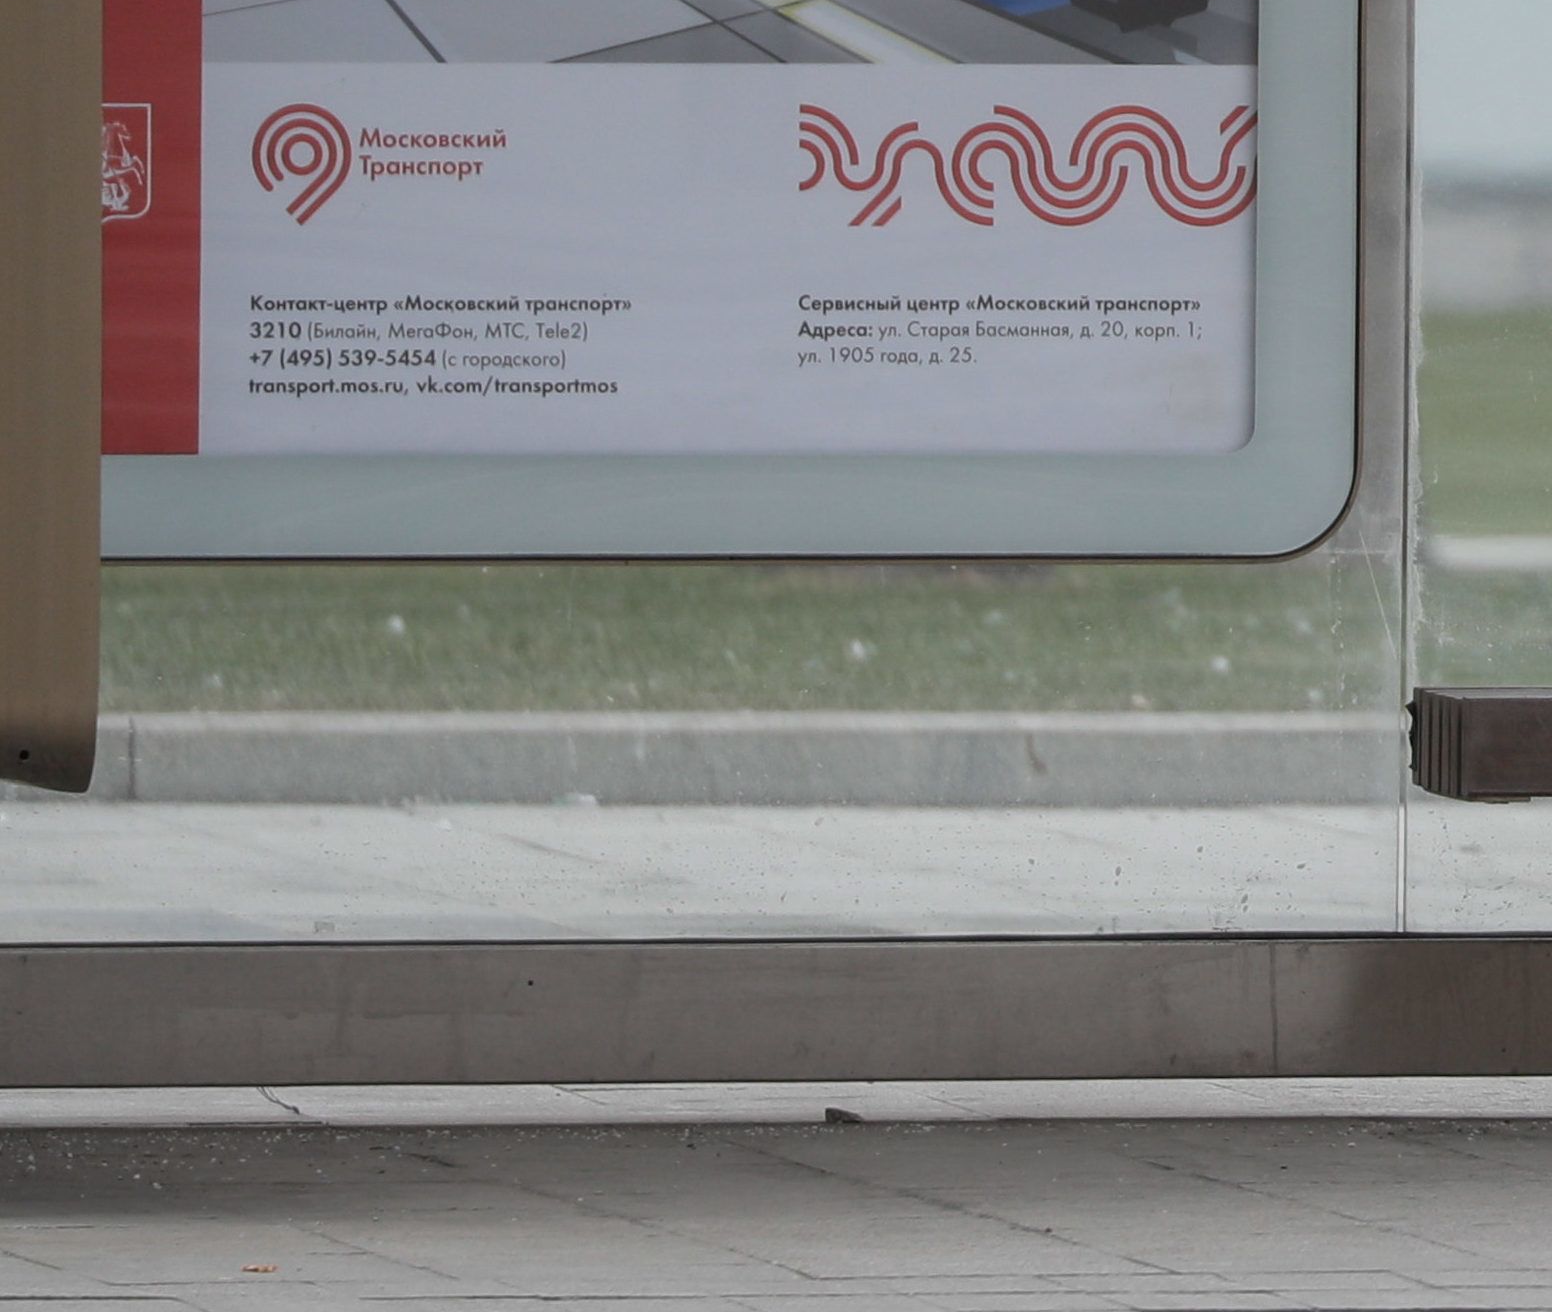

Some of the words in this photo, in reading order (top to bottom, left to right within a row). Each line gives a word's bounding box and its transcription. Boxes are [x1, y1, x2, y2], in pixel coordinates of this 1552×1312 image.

[359, 127, 507, 149] Московский
[359, 155, 484, 181] Транспорт
[250, 295, 388, 315] Контакт-центр
[394, 294, 520, 313] «Московский
[525, 299, 632, 316] транспорт»
[798, 294, 902, 315] Сервисный
[906, 299, 960, 315] центр
[966, 294, 1090, 311] «Московский
[1095, 299, 1201, 316] транспорт»
[250, 320, 302, 340] 3210
[307, 320, 381, 342] (Билайн,
[387, 321, 478, 342] МегаФон,
[485, 322, 529, 342] МТС,
[535, 321, 588, 342] Tele2)
[798, 320, 873, 343] Адреса:
[878, 326, 902, 342] ул.
[907, 320, 970, 339] Старая
[975, 320, 1074, 340] Басманная,
[1080, 325, 1095, 341] д.
[1100, 320, 1128, 340] 20,
[1134, 326, 1180, 342] корп.
[1187, 321, 1202, 340] 1;
[249, 349, 274, 367] +7
[279, 347, 333, 371] (495)
[338, 348, 437, 368] 539-5454
[442, 349, 457, 370] (с
[462, 348, 566, 371] городского)
[798, 351, 822, 368] ул.
[828, 346, 875, 364] 1905
[880, 351, 923, 367] года,
[929, 351, 944, 366] д.
[949, 345, 977, 364] 25.
[249, 377, 409, 398] transport.mos.ru,
[416, 375, 618, 398] vk.com/transportmos
